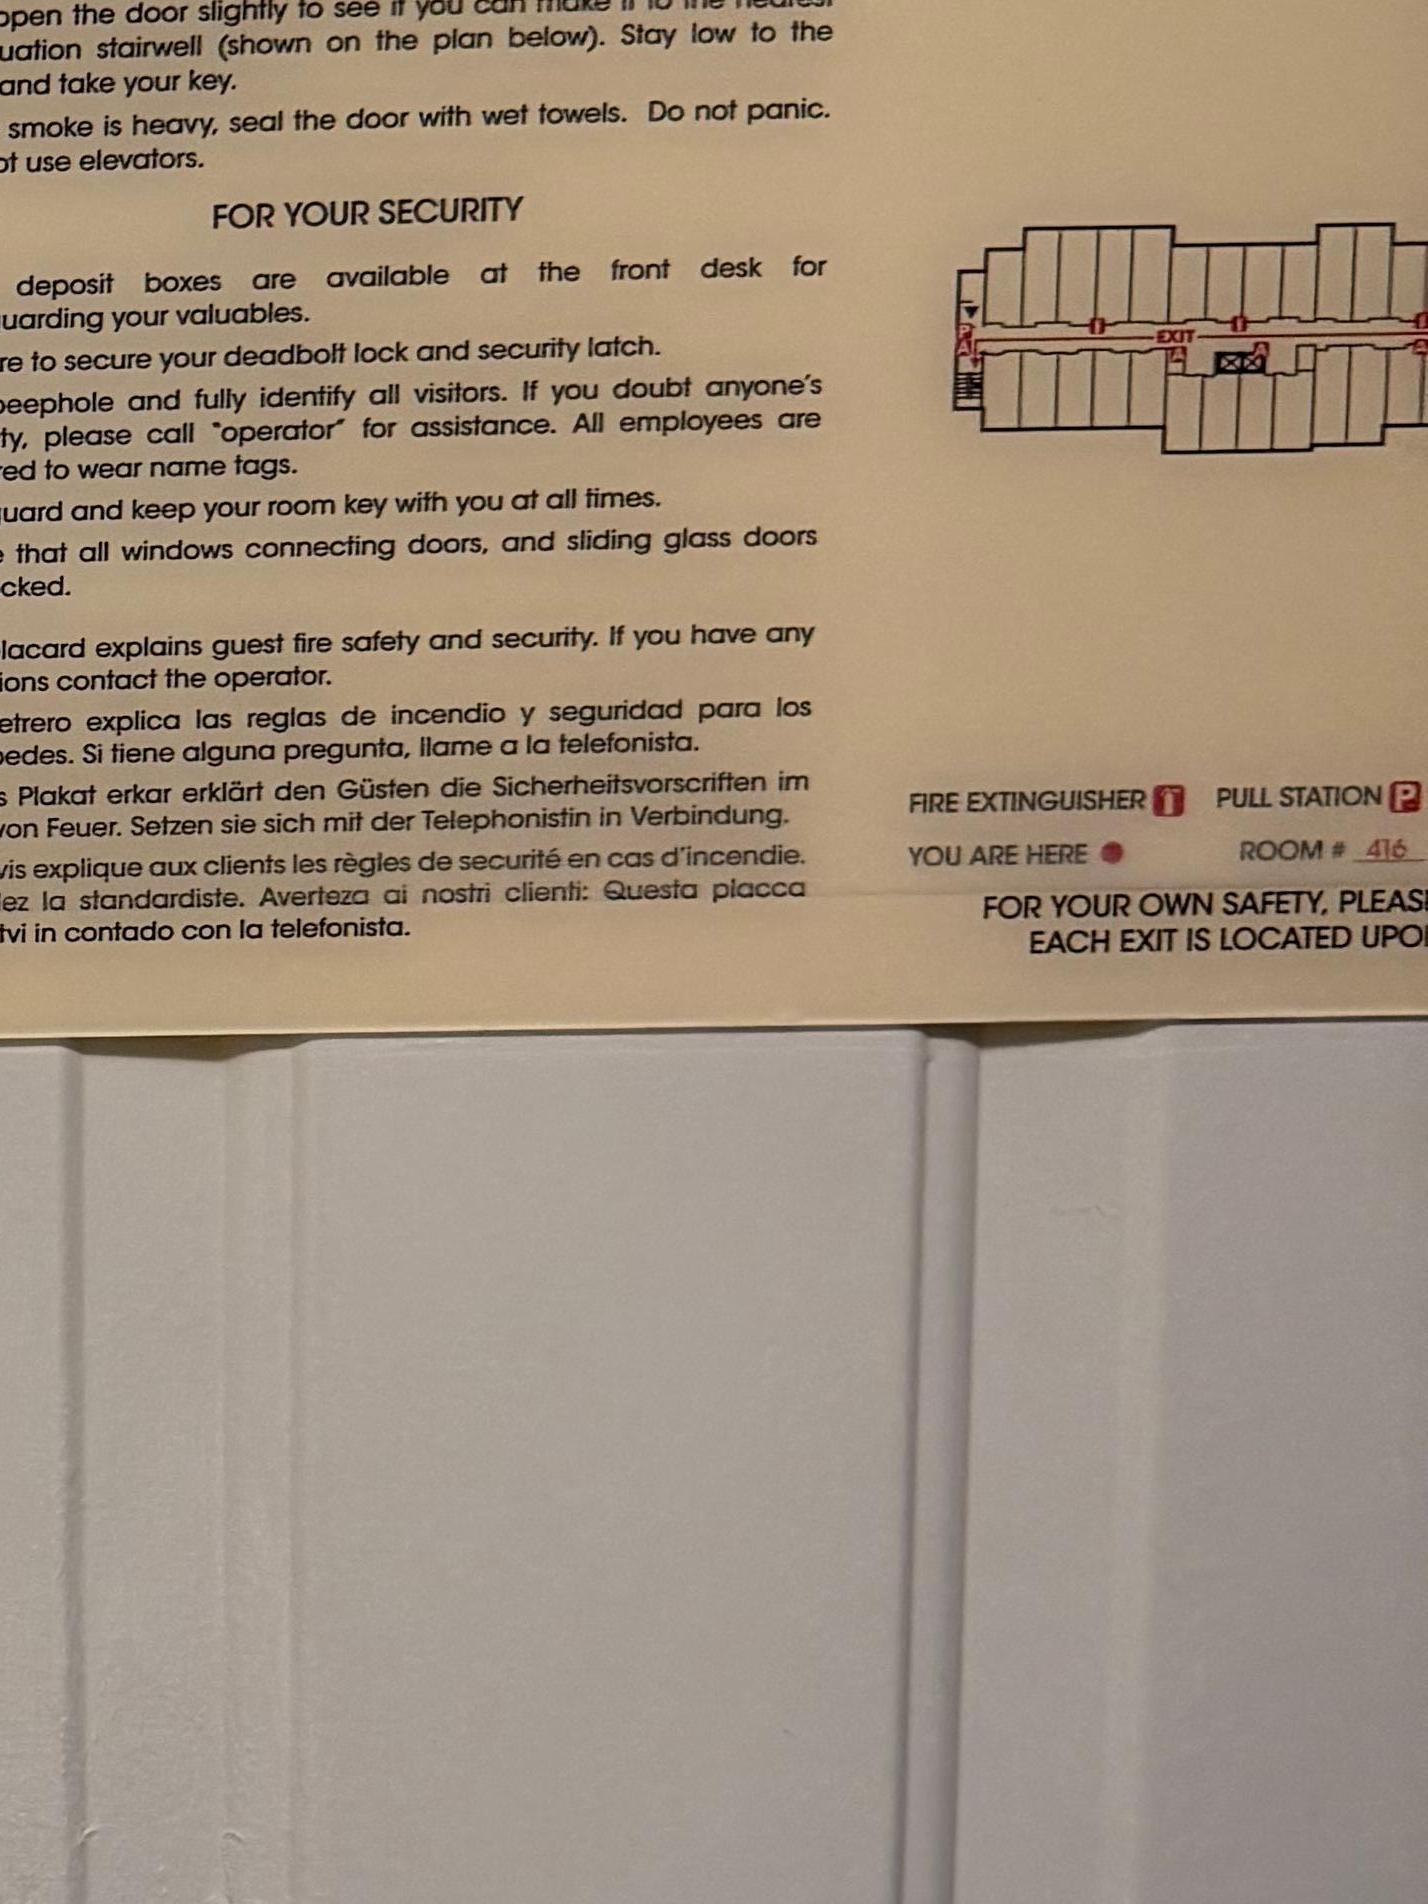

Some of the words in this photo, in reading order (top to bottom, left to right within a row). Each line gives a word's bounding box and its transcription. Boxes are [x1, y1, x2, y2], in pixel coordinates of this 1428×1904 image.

[72, 3, 115, 26] the
[125, 2, 189, 24] door
[334, 0, 381, 18] see
[58, 72, 116, 94] take
[123, 75, 182, 98] your
[189, 69, 236, 95] key.
[26, 155, 72, 173] use
[79, 147, 204, 171] elevators.
[213, 203, 276, 229] FOR
[283, 200, 370, 227] YOUR
[378, 196, 525, 225] SECURITY
[111, 309, 170, 332] your
[176, 302, 310, 325] valuables.
[1156, 330, 1196, 344] EXIT
[128, 389, 181, 411] and
[194, 388, 247, 414] fully
[260, 384, 356, 411] identify
[369, 384, 400, 405] all
[414, 382, 507, 404] visitors.
[523, 380, 539, 402] If
[551, 384, 599, 406] you
[612, 376, 692, 399] doubt
[44, 459, 70, 480] to
[77, 462, 143, 479] wear
[150, 460, 226, 477] name
[233, 454, 298, 480] tags.
[16, 542, 68, 564] that
[79, 541, 109, 563] all
[121, 539, 234, 561] windows
[245, 535, 396, 561] connecting
[407, 533, 488, 555] doors,
[501, 531, 556, 552] and
[567, 528, 653, 555] sliding
[663, 527, 732, 555] glass
[743, 526, 818, 547] doors
[56, 668, 158, 691] contact
[164, 668, 207, 688] the
[214, 665, 332, 692] operator.
[86, 710, 180, 736] explica
[196, 709, 232, 729] las
[247, 707, 327, 734] reglas
[341, 705, 376, 726] de
[391, 702, 506, 725] incendio
[520, 706, 536, 727] y
[549, 698, 683, 727] seguridad
[698, 702, 762, 724] para
[776, 696, 813, 717] los
[82, 743, 103, 764] Si
[110, 742, 175, 763] tiene
[183, 741, 275, 767] alguna
[284, 737, 410, 765] pregunta,
[420, 736, 493, 757] llame
[500, 740, 519, 755] a
[526, 734, 551, 754] la
[558, 731, 699, 754] telefonista.
[909, 792, 960, 814] FIRE
[966, 789, 1147, 813] EXTINGUISHER
[1217, 787, 1273, 808] PULL
[1279, 785, 1383, 808] STATION
[47, 817, 122, 838] Feuer.
[130, 816, 213, 836] Setzen
[221, 814, 257, 834] sie
[263, 812, 315, 833] sich
[324, 811, 364, 832] mit
[371, 811, 416, 831] der
[421, 807, 591, 834] Telephonistin
[600, 806, 622, 826] in
[630, 804, 789, 829] Verbindung.
[908, 845, 962, 867] YOU
[968, 844, 1019, 866] ARE
[1026, 843, 1088, 865] HERE
[1240, 839, 1324, 861] ROOM
[1366, 838, 1408, 860] 416
[983, 895, 1042, 920] FOR
[1050, 893, 1131, 918] YOUR
[1138, 892, 1214, 917] OWN
[1222, 890, 1328, 916] SAFETY,
[1339, 888, 1428, 913] PLEAS
[35, 923, 56, 943] in
[64, 920, 175, 942] contado
[181, 924, 232, 940] con
[240, 919, 263, 939] la
[270, 916, 411, 939] telefonista.
[1029, 929, 1110, 954] EACH
[1120, 928, 1179, 953] EXIT
[1186, 927, 1211, 952] IS
[1220, 926, 1353, 951] LOCATED
[1361, 924, 1428, 949] UPO
